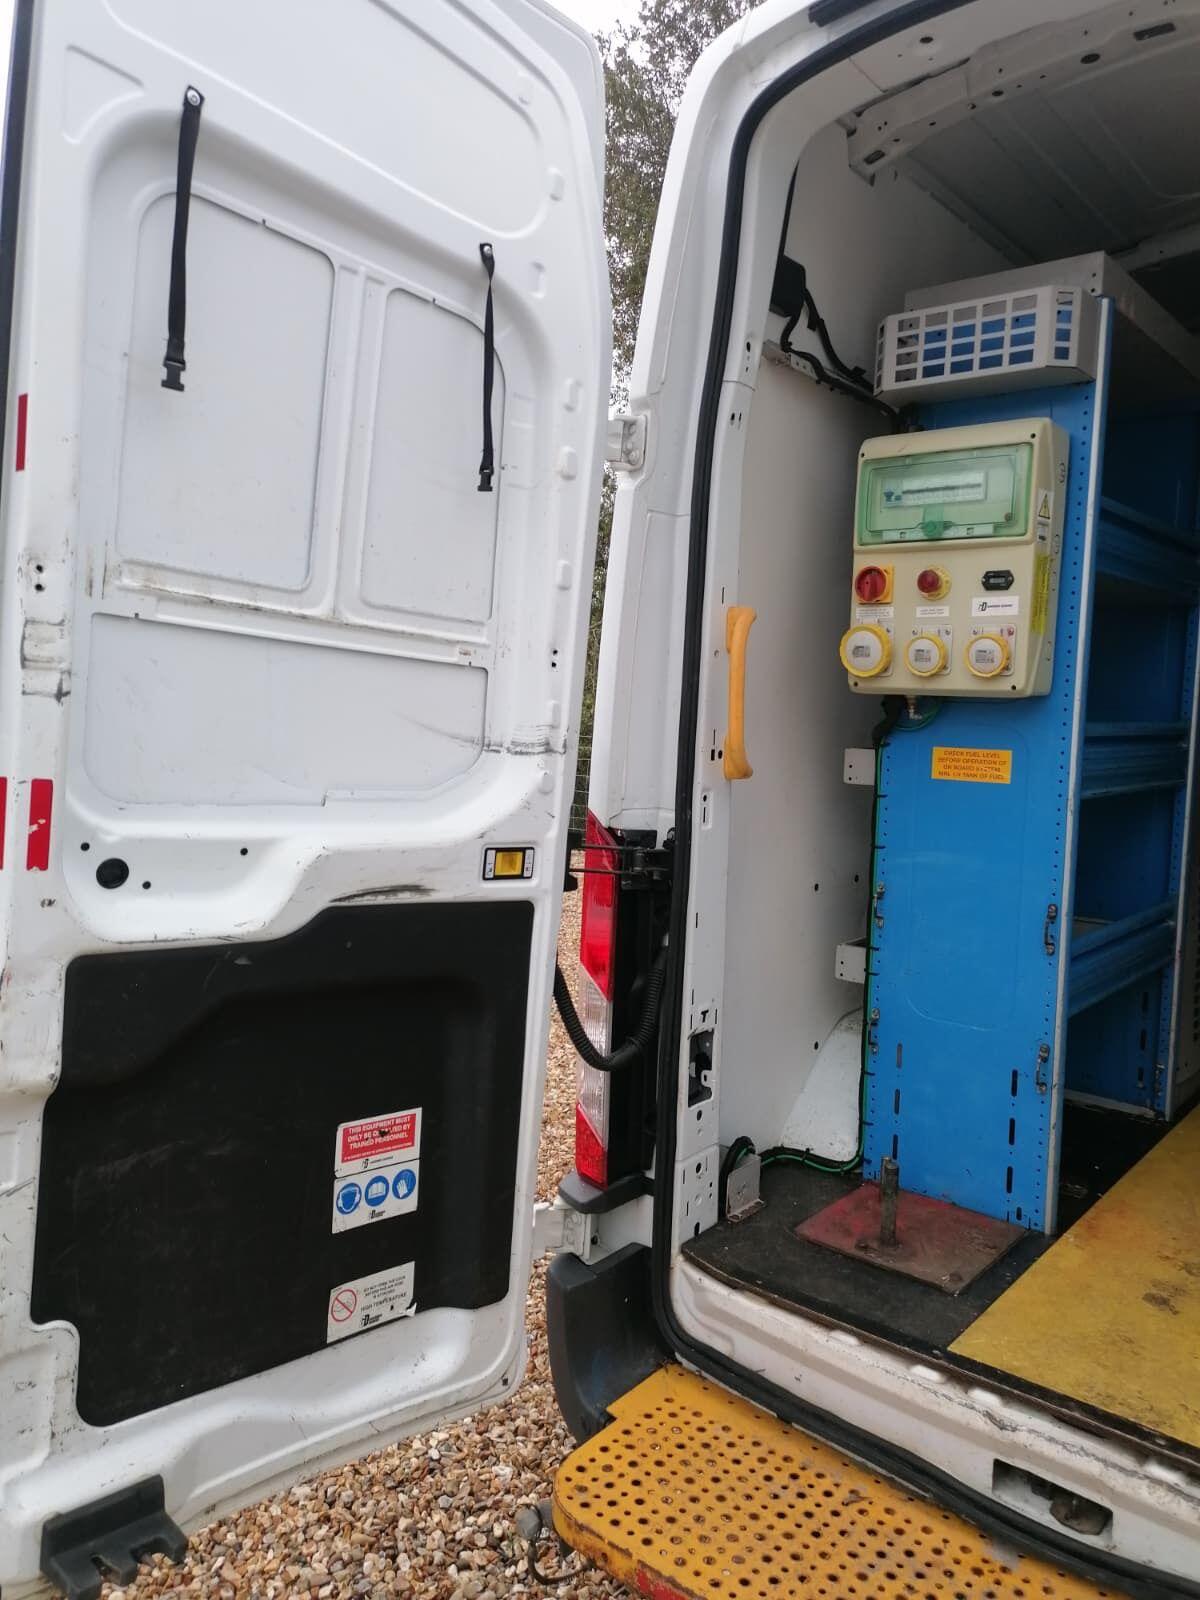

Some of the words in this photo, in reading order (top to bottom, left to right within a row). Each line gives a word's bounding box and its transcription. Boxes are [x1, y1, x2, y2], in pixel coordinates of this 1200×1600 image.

[347, 1133, 362, 1142] ONLY
[372, 1125, 402, 1137] OPTED
[349, 1126, 362, 1134] THIS
[362, 1118, 394, 1132] EQUIPMENT
[395, 1116, 411, 1124] MUST
[350, 1138, 374, 1150] TRAINED
[375, 1132, 408, 1144] PERSONNEL
